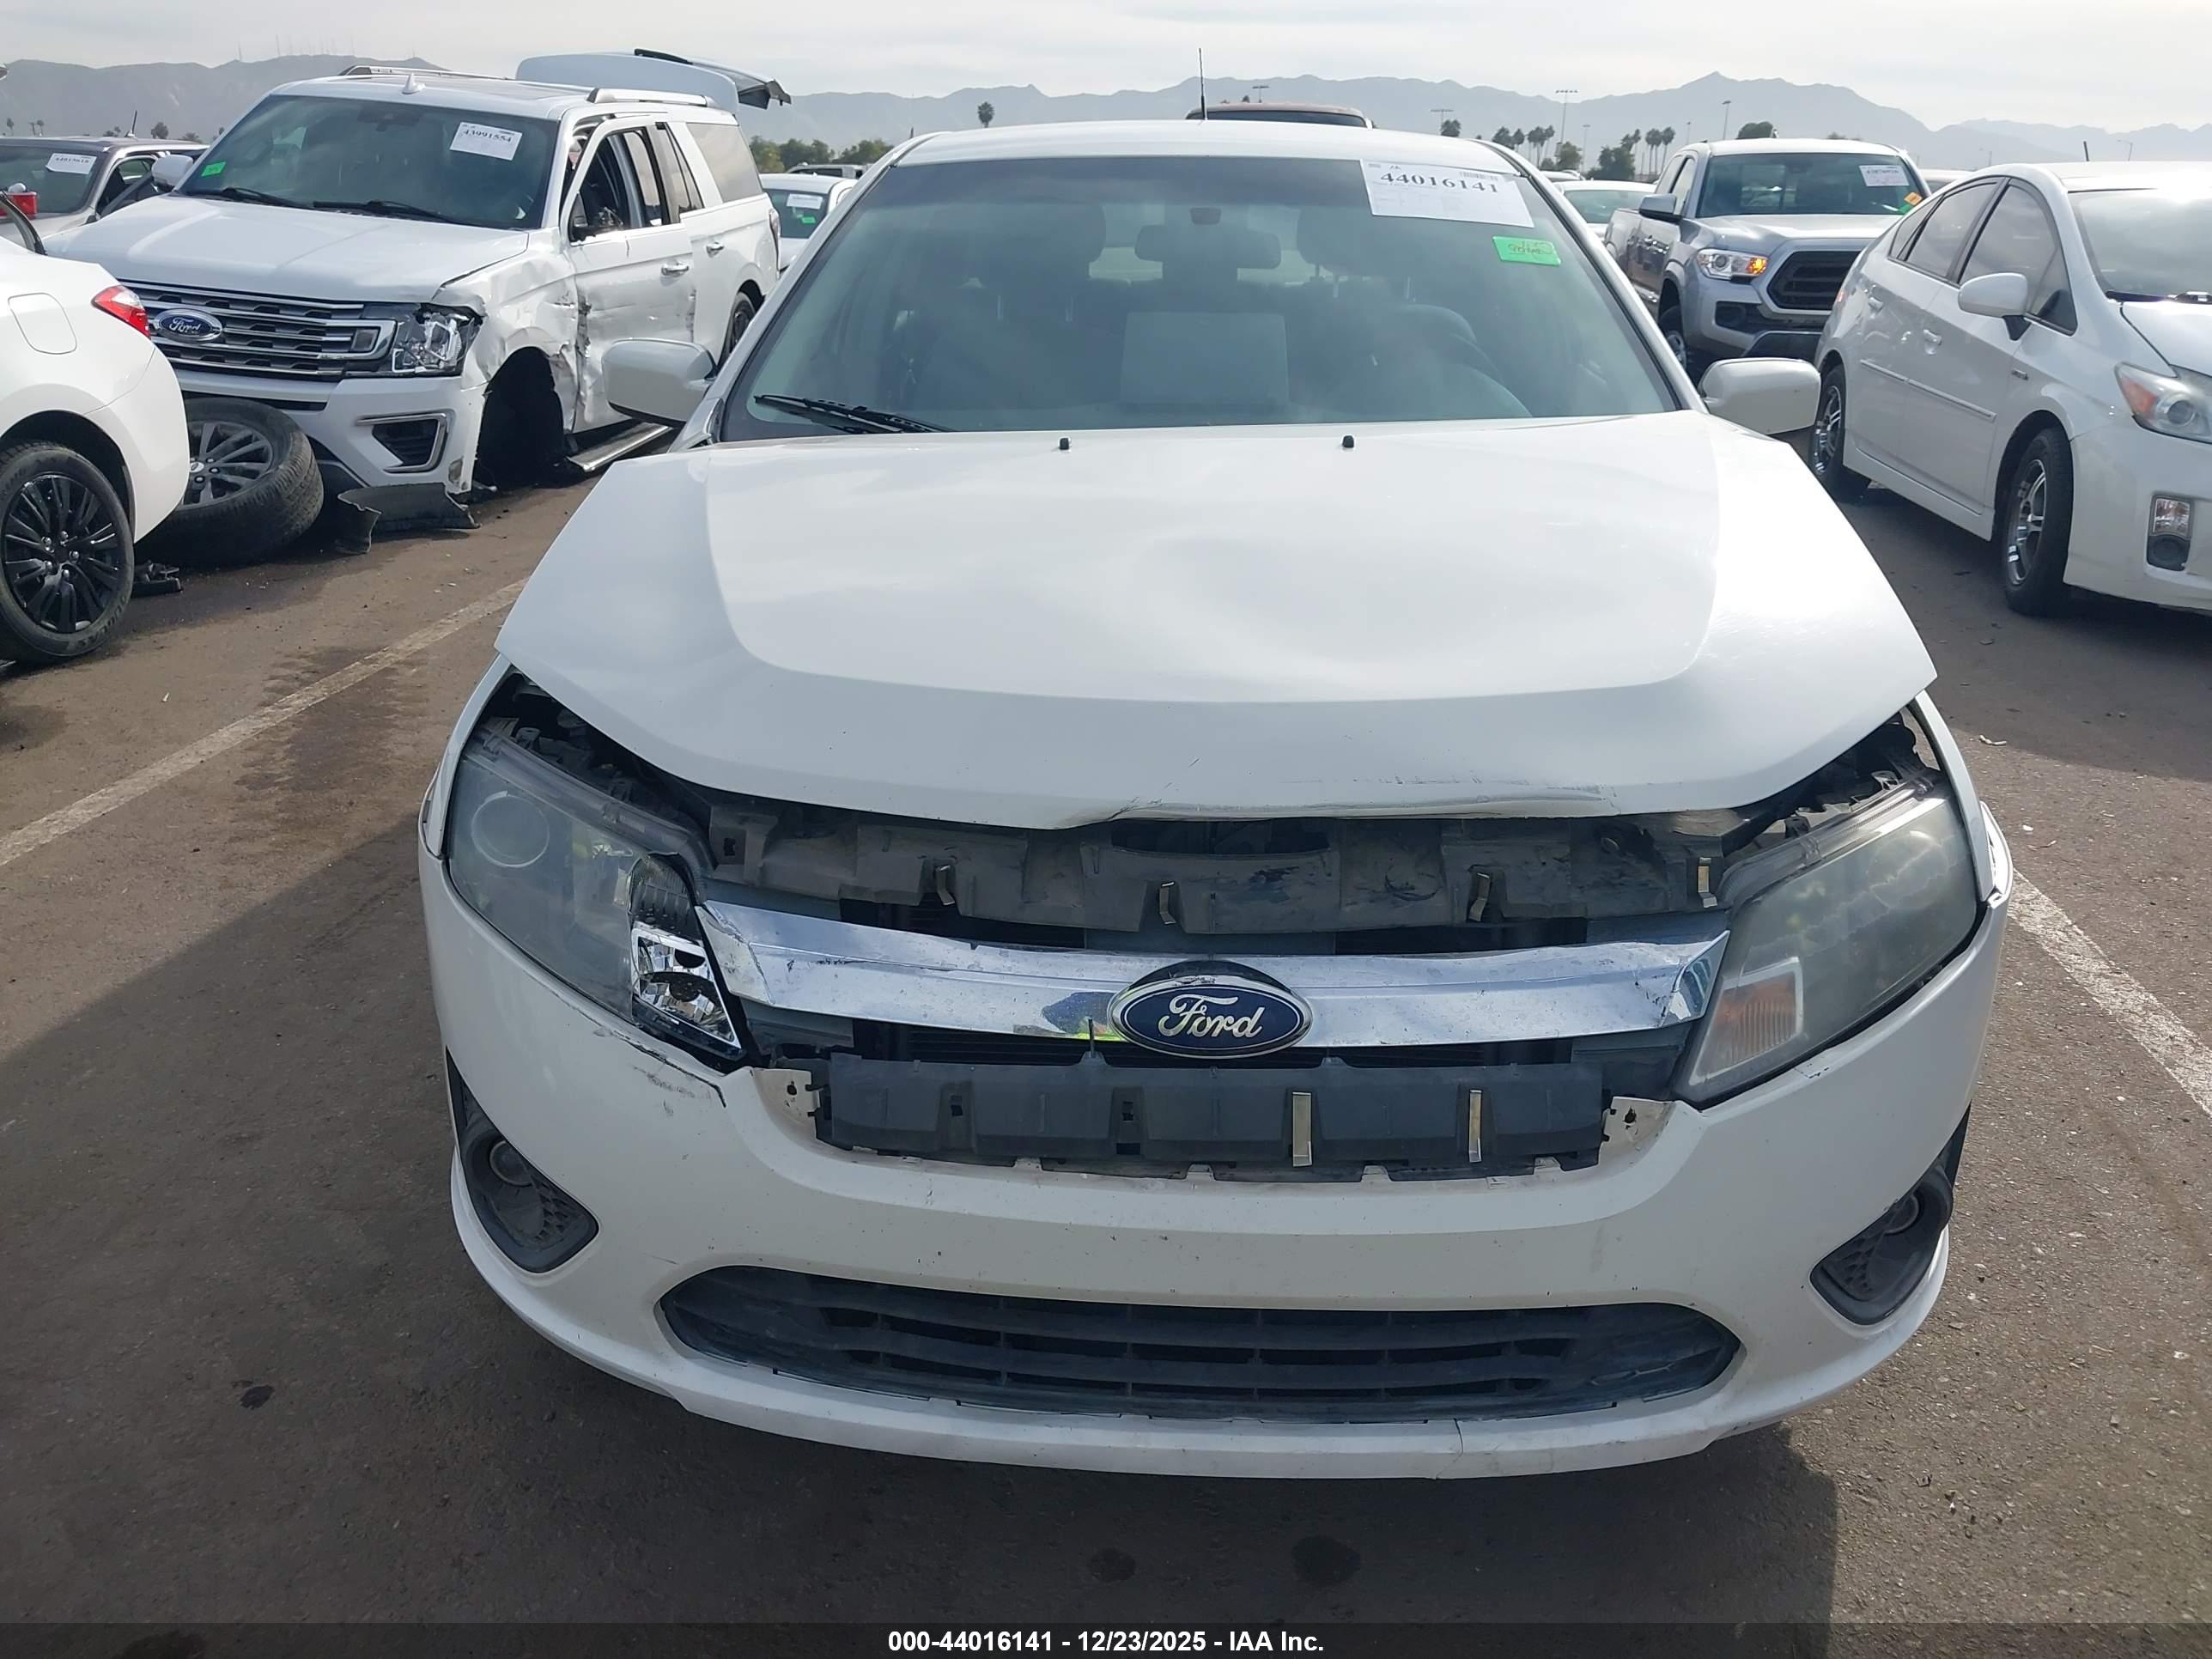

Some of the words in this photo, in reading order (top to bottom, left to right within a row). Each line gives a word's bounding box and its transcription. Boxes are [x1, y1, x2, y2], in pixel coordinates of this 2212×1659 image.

[1380, 172, 1499, 192] 44016141
[168, 317, 202, 334] Ford
[1157, 994, 1266, 1038] Ford
